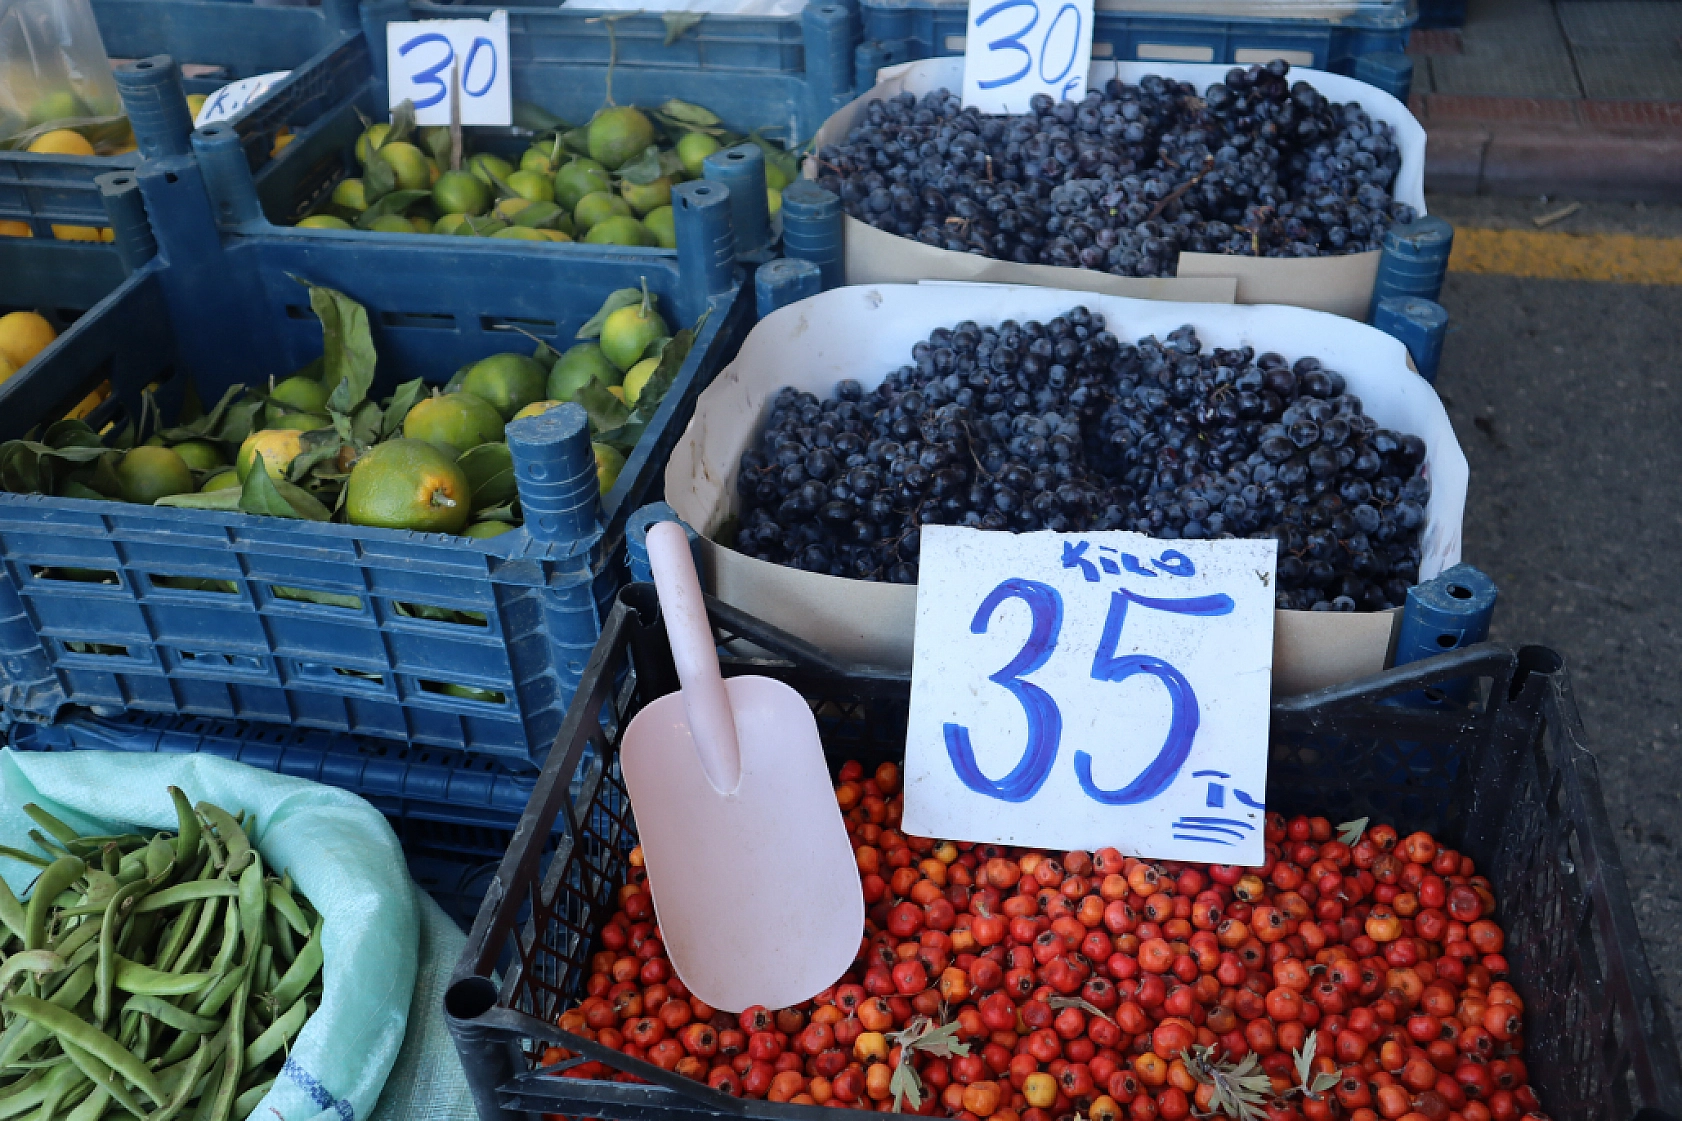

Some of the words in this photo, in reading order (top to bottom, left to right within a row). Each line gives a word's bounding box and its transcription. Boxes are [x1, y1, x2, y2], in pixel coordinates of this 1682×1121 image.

[397, 33, 497, 110] 30
[975, 0, 1081, 90] 30
[942, 577, 1235, 806] 35
